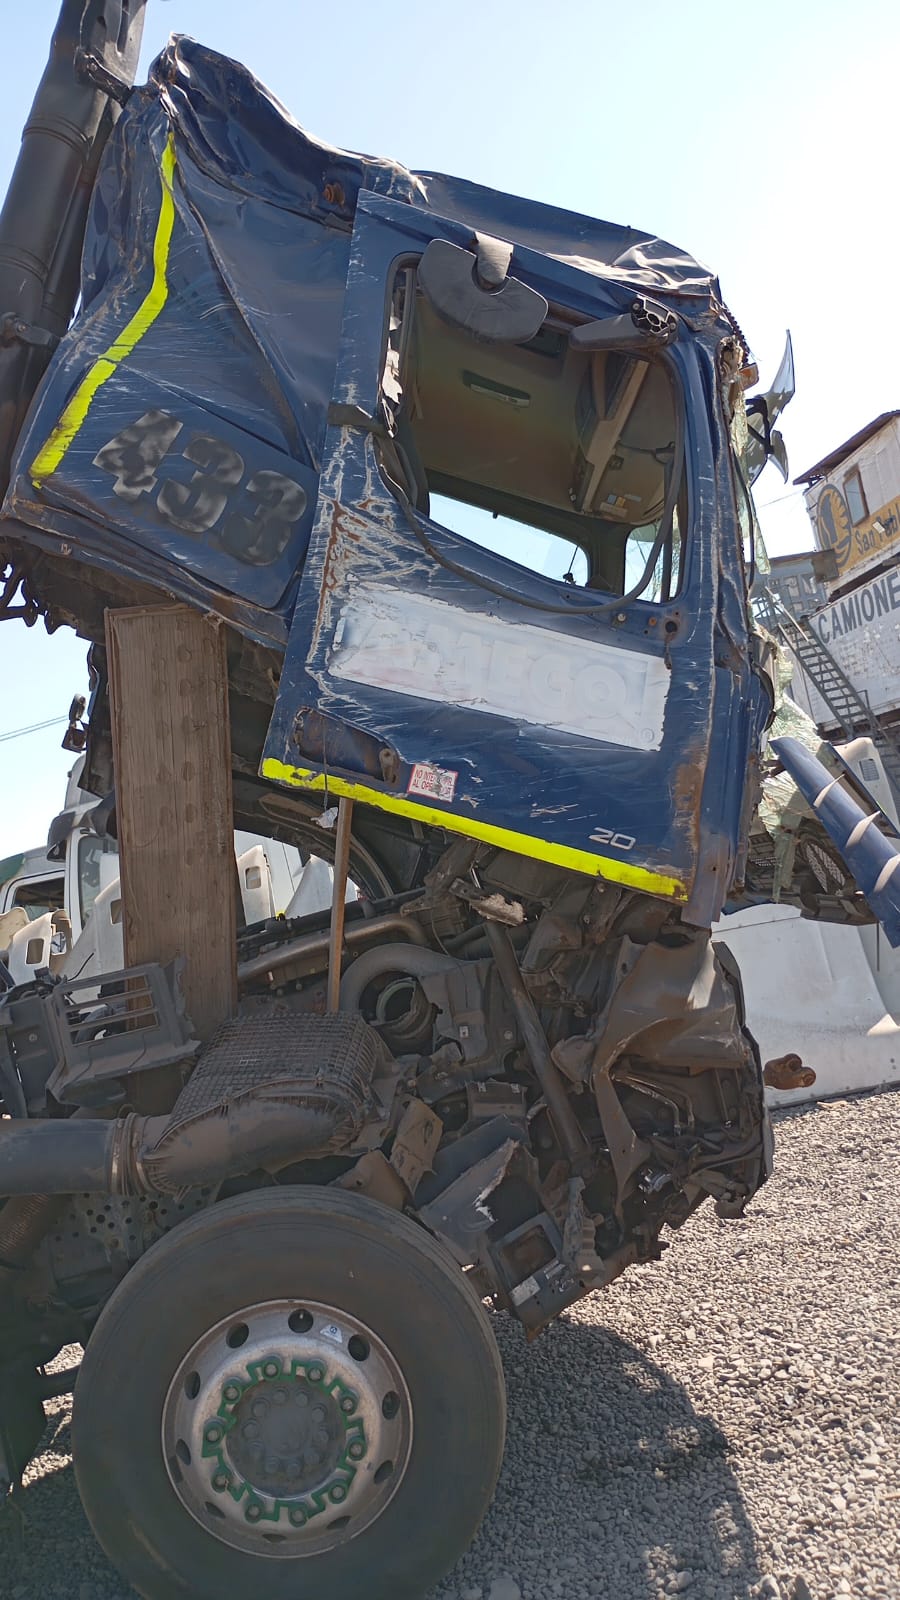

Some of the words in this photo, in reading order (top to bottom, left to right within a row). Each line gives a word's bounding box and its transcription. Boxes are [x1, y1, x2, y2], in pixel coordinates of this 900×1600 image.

[92, 408, 308, 567] 433
[855, 529, 876, 556] San
[818, 570, 900, 645] CAMIONE
[412, 779, 420, 788] AL
[415, 769, 423, 779] NO
[588, 826, 636, 851] 20
